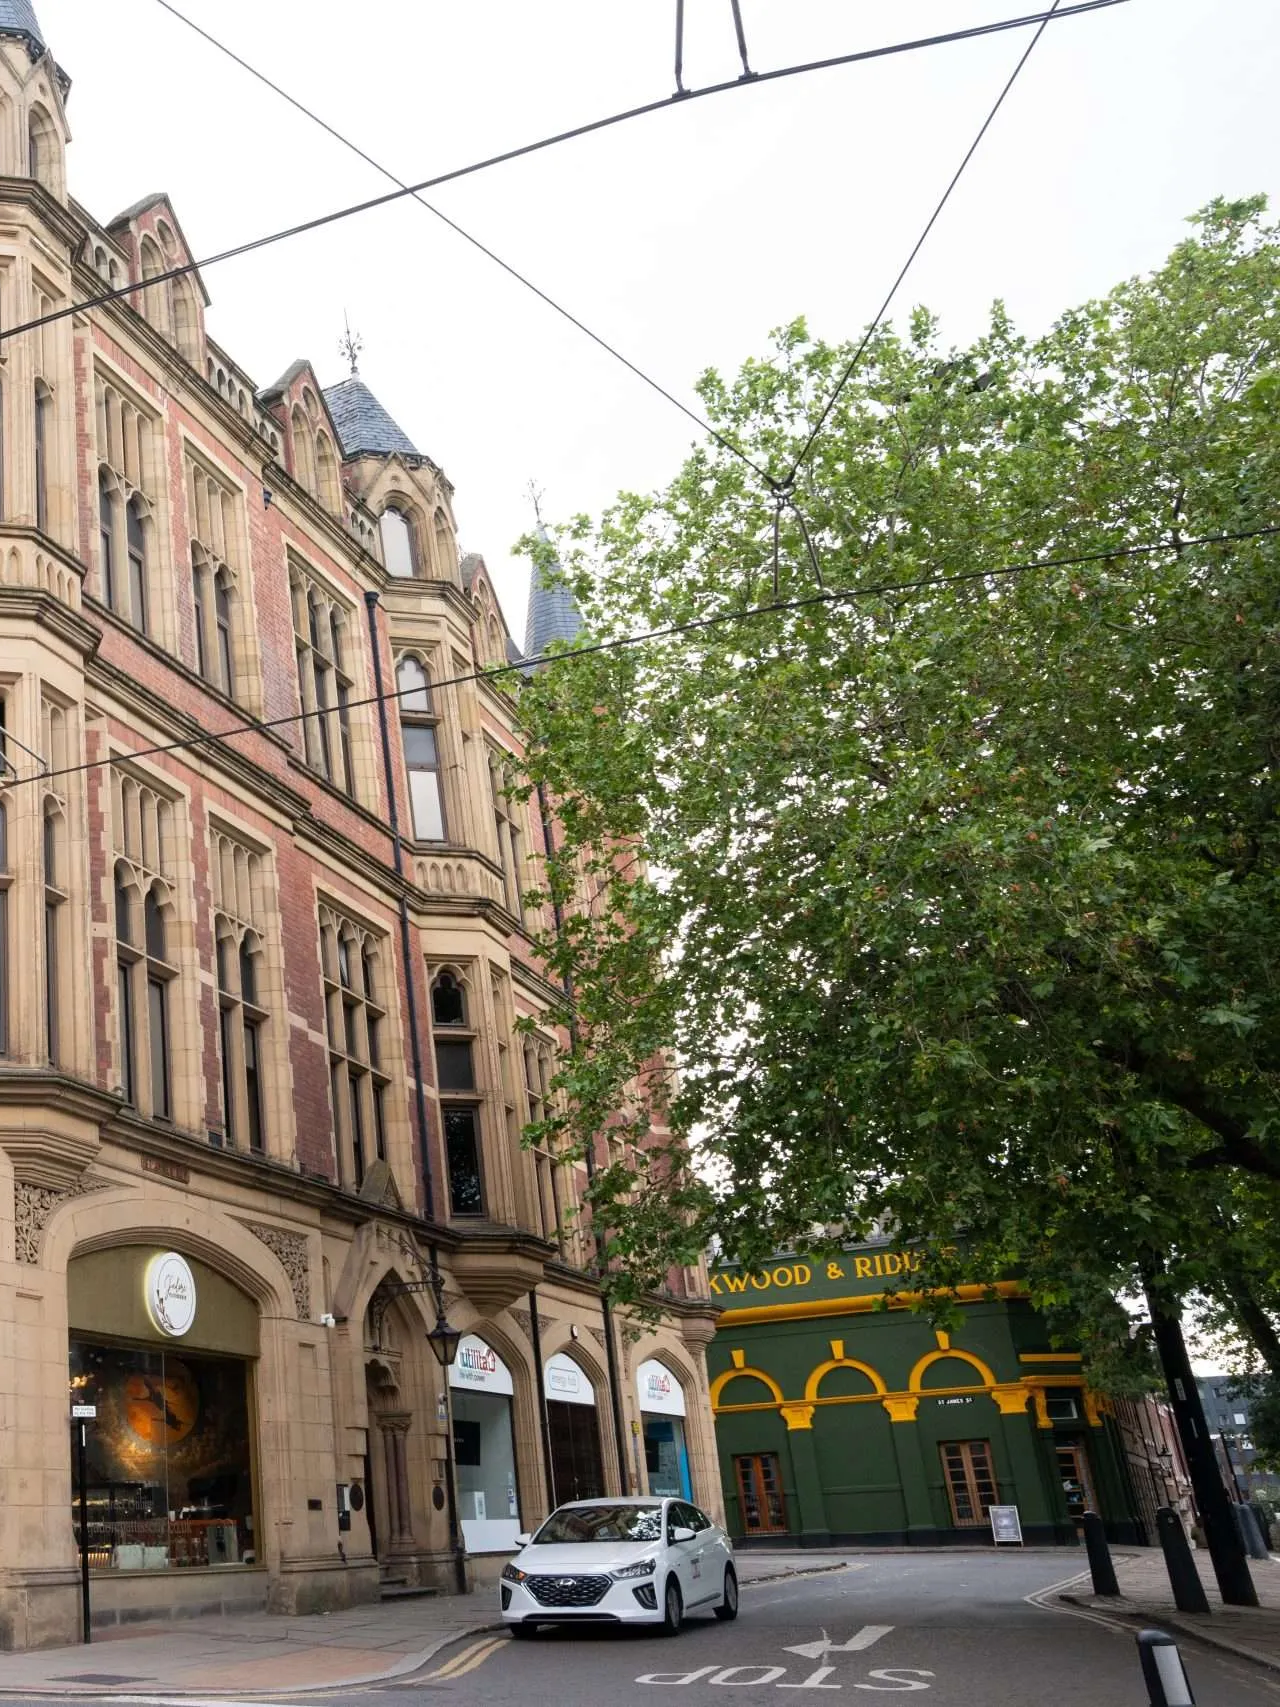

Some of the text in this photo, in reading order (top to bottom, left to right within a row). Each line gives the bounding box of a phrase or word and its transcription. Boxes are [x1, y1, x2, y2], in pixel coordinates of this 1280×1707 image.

[827, 1262, 845, 1280] &
[460, 1348, 490, 1371] utilita
[633, 1664, 937, 1691] STOP
